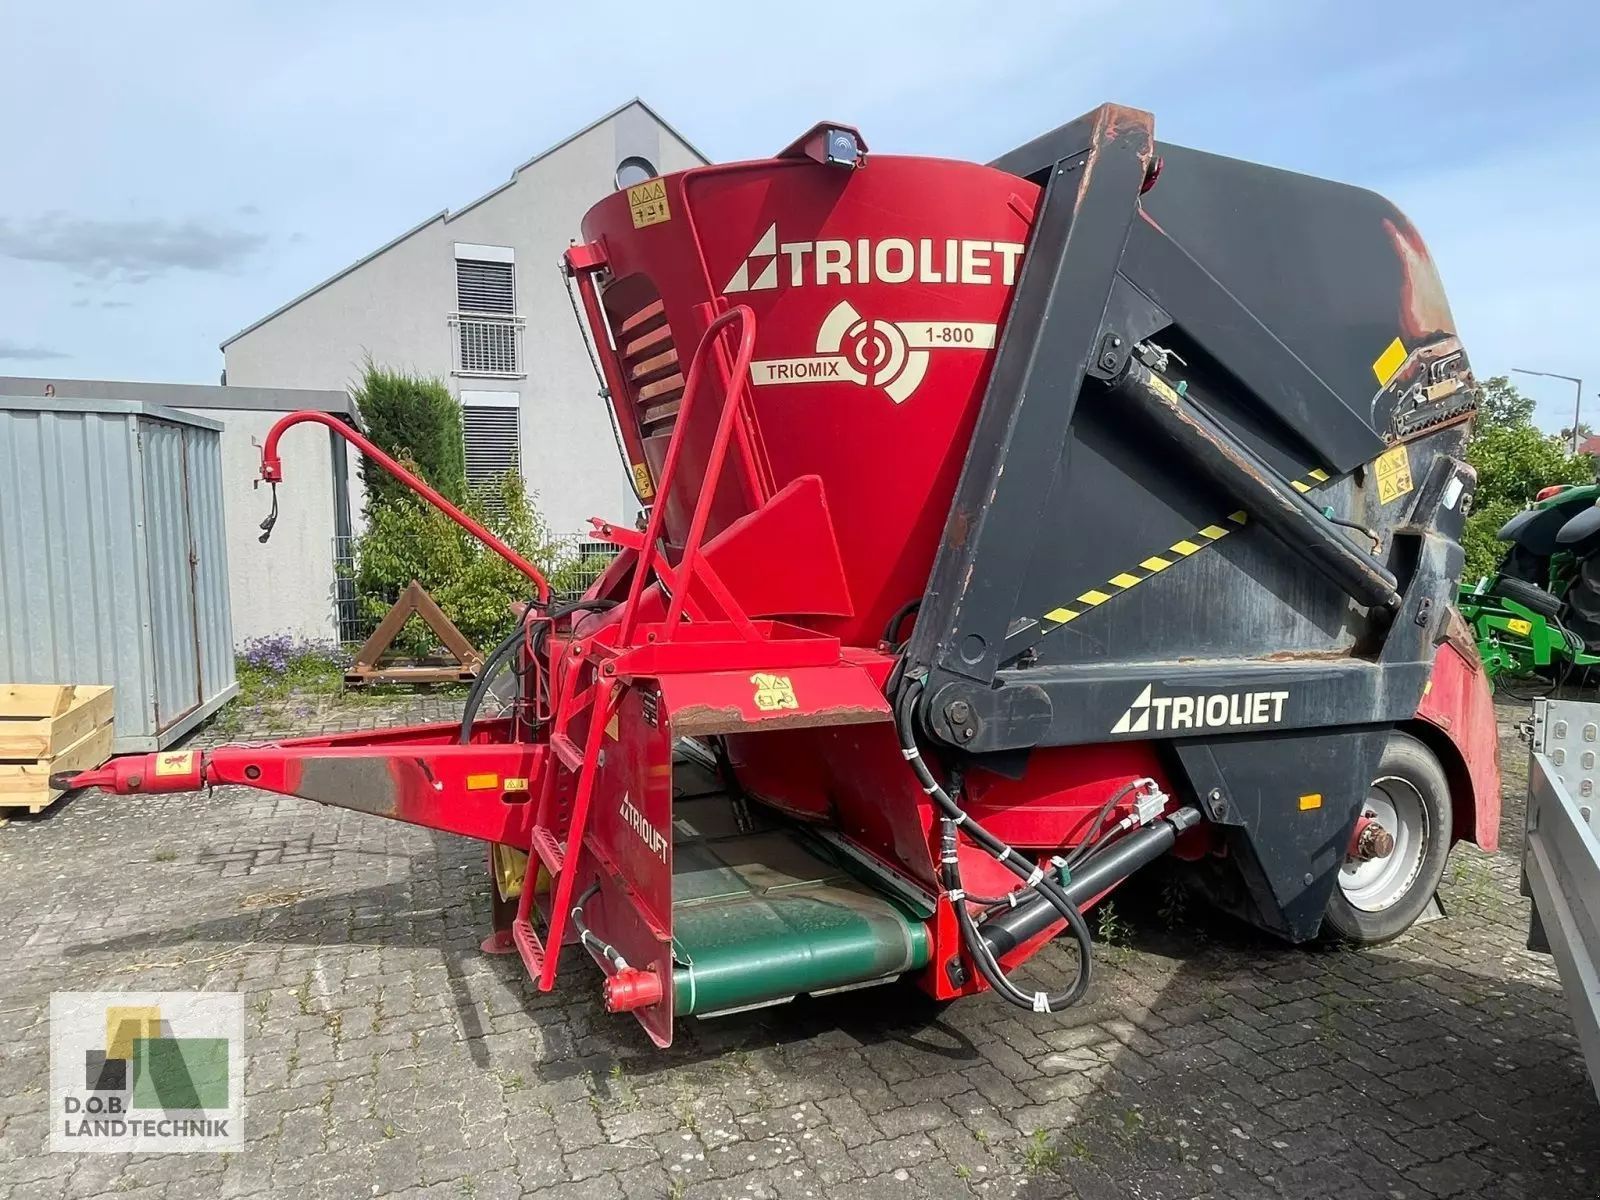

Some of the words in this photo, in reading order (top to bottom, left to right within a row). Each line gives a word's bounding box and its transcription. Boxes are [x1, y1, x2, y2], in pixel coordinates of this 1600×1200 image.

[780, 238, 1025, 287] TRIOLIET
[925, 327, 974, 344] 1-800
[767, 361, 840, 380] TRIOMIX
[1151, 691, 1289, 731] TRIOLIET
